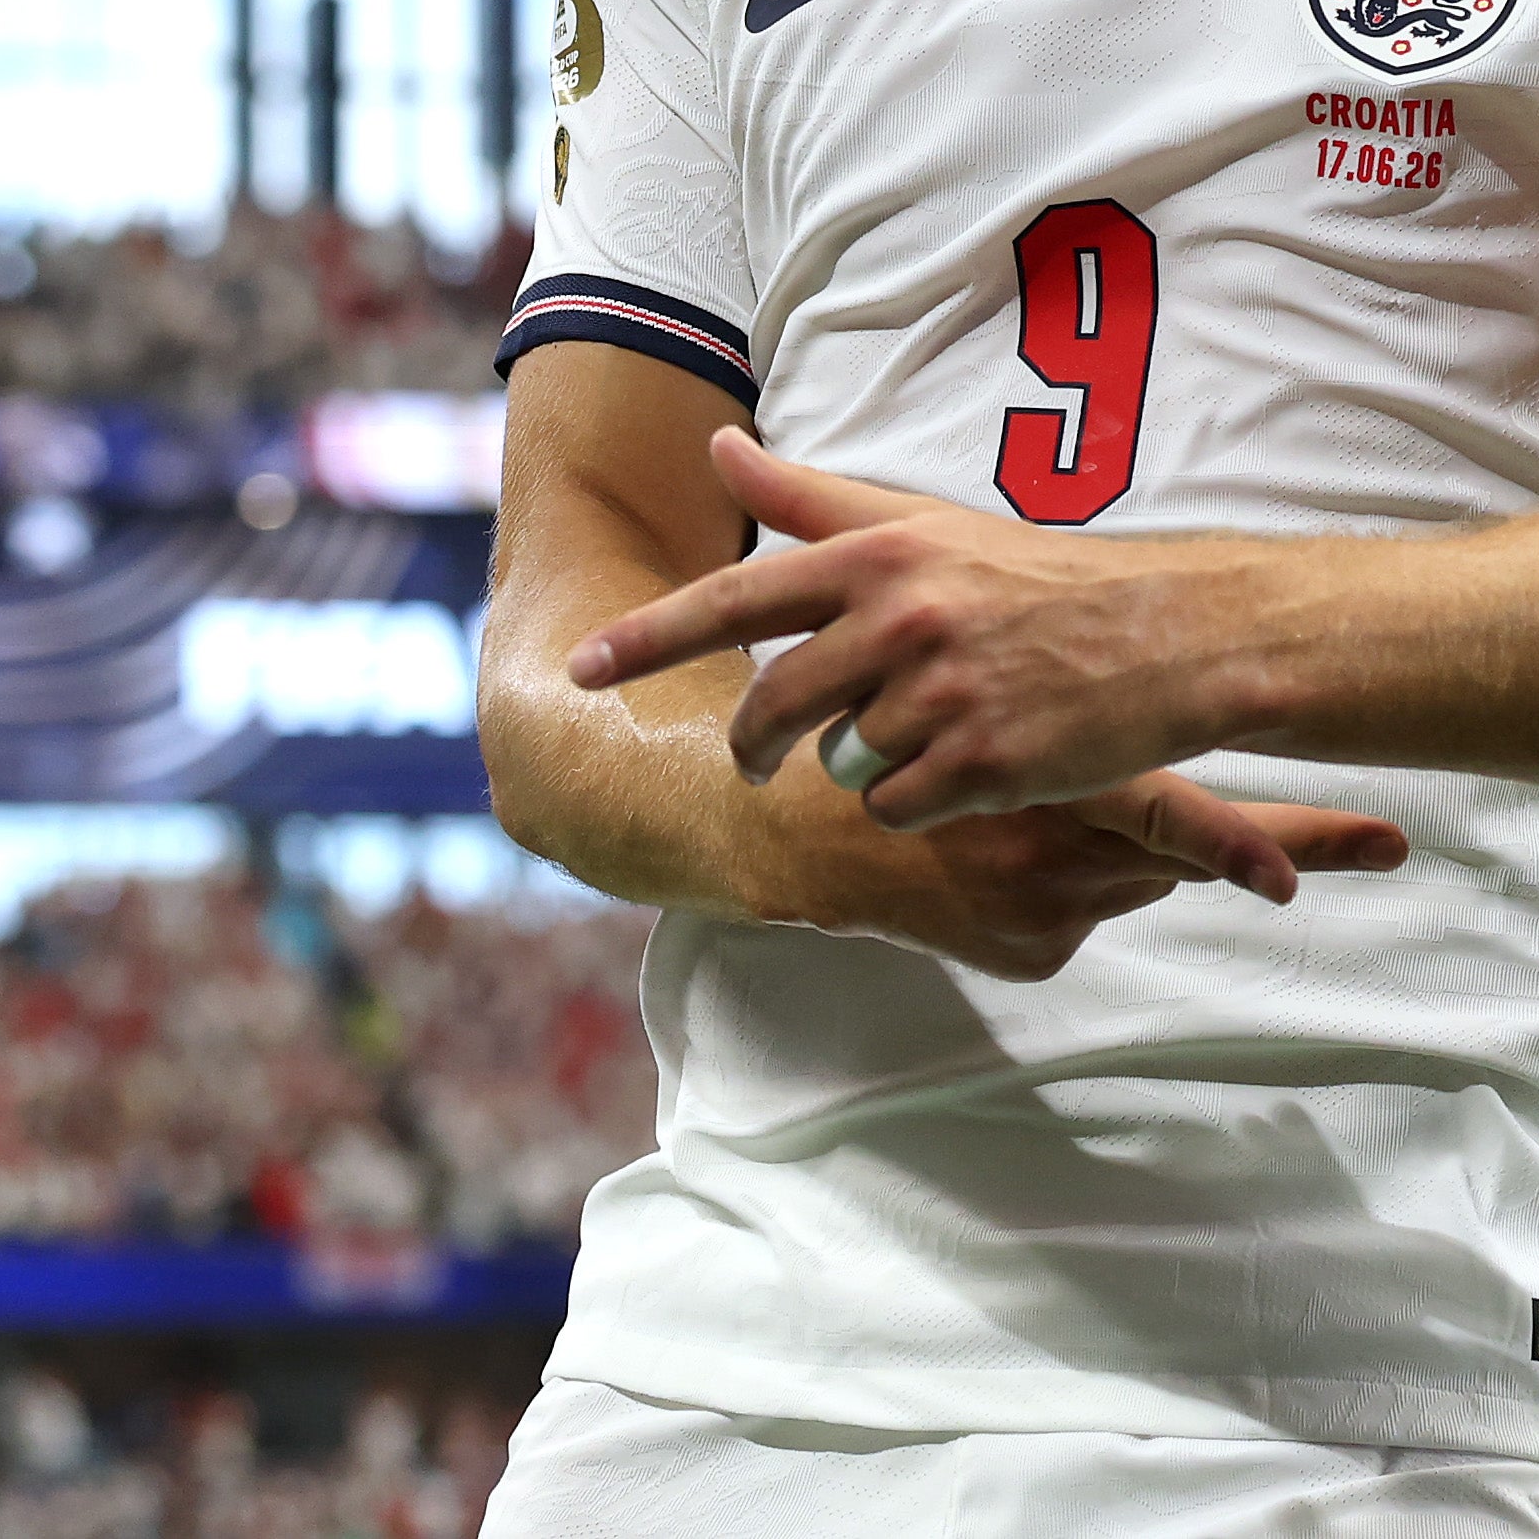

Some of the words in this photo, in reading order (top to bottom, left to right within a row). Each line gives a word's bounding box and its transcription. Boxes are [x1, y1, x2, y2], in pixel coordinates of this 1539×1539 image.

[1306, 93, 1456, 137] CROATIA
[1317, 138, 1443, 189] 17.06.26
[993, 198, 1159, 526] 9
